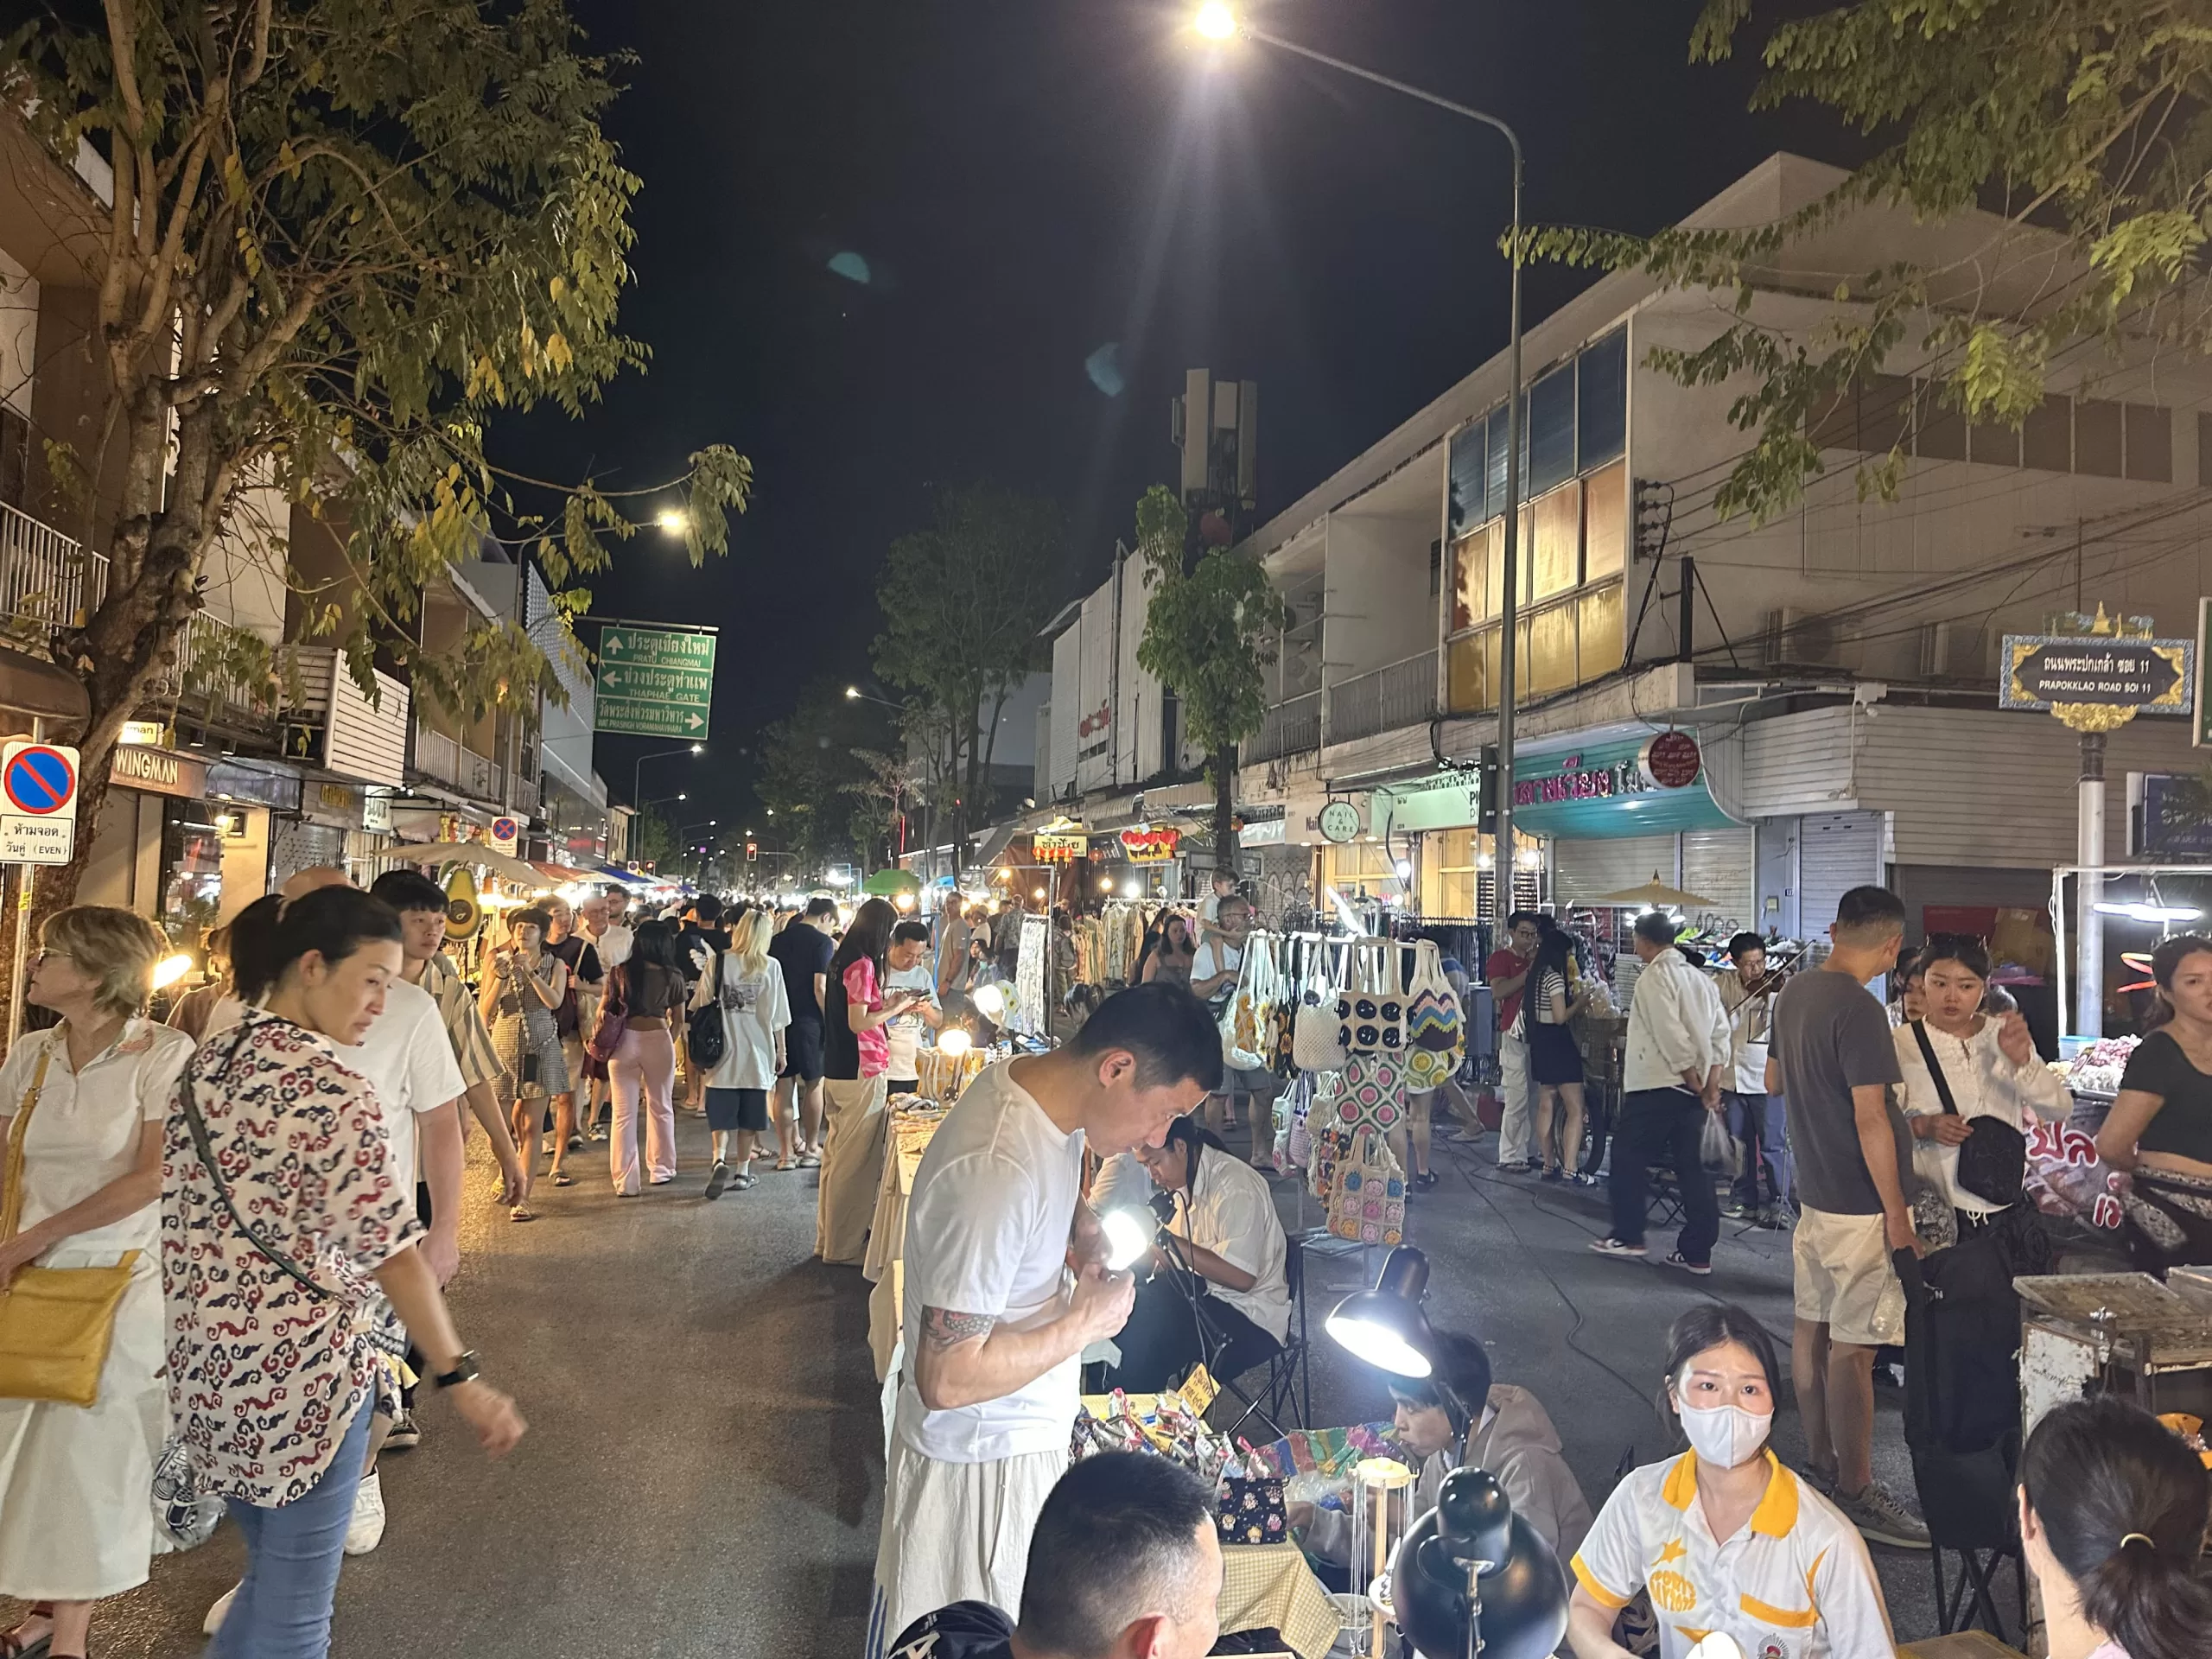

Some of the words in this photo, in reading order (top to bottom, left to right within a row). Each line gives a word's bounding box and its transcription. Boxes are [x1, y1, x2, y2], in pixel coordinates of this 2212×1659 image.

[628, 632, 709, 657] ประตูเชียงใหม่
[632, 654, 657, 664] PRATU
[661, 656, 702, 668] CHIANGMAI
[2044, 652, 2113, 673] ถนนพระปกเกล้า
[2117, 658, 2135, 673] ซอย
[2140, 659, 2150, 674] 11
[2039, 680, 2095, 691] PRAPOKKLAO
[2098, 681, 2121, 692] ROAD
[2125, 682, 2139, 693] SOI
[2142, 683, 2151, 693] 11
[629, 689, 670, 701] THAPHAE
[676, 692, 700, 702] GATE
[598, 718, 609, 727] WAT
[116, 748, 178, 785] WINGMAN
[14, 823, 59, 837] ห้ามจอด
[1327, 824, 1354, 833] CARE
[6, 841, 26, 856] วันคู่
